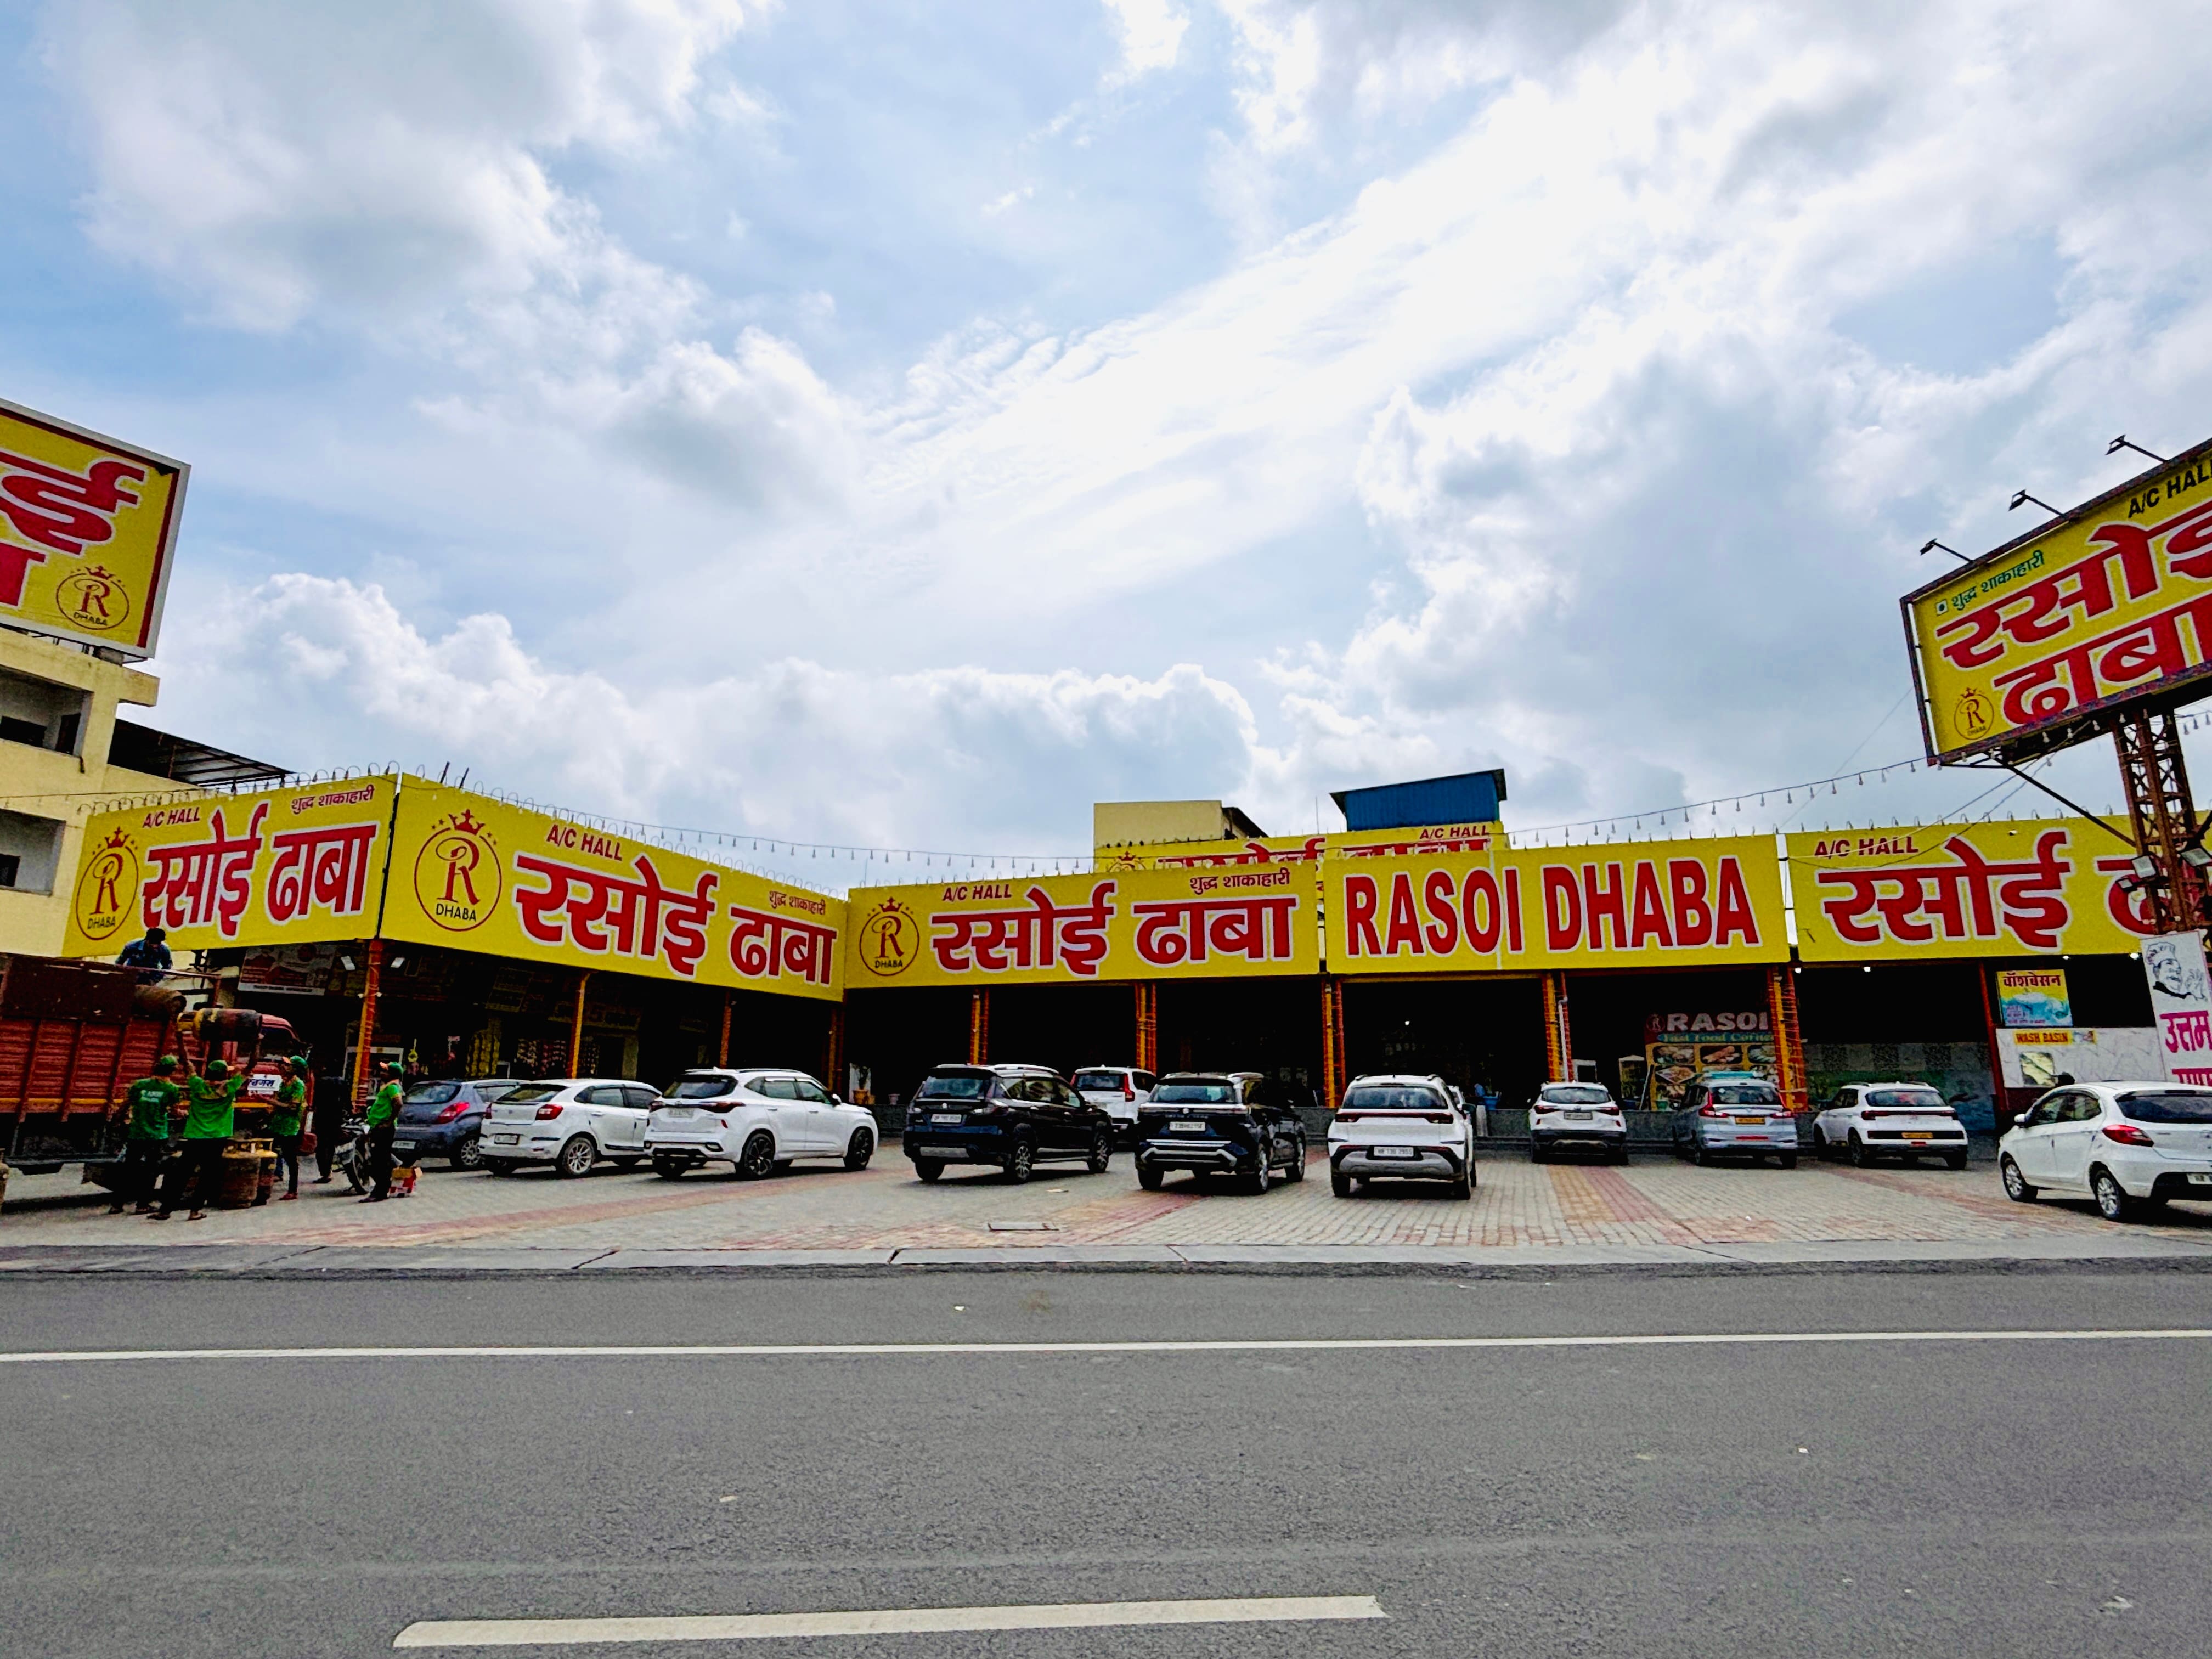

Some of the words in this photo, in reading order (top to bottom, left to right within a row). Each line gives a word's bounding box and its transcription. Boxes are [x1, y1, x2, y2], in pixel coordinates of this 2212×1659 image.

[2129, 488, 2159, 518] A/C
[2167, 460, 2212, 499] HAL
[1952, 586, 1978, 611] शुद्ध
[1981, 550, 2045, 592] शाकाहारी
[74, 612, 108, 626] DHABA
[292, 798, 314, 815] शुद्ध
[319, 784, 375, 808] शाकाहारी
[143, 810, 164, 828] A/C
[167, 806, 200, 825] HALL
[546, 825, 577, 849] A/C
[581, 835, 623, 861] HALL
[1419, 828, 1444, 840] A/C
[1449, 825, 1489, 838] HALL
[1814, 840, 1850, 859] A/C
[1858, 835, 1919, 856] HALL
[143, 802, 269, 936] रसोई
[268, 824, 376, 922] ढाबा
[942, 885, 967, 902] A/C
[972, 884, 1012, 900] HALL
[1189, 877, 1218, 895] शुद्ध
[1223, 870, 1290, 890] शाकाहारी
[1818, 831, 2070, 948] रसोई
[436, 902, 476, 922] DHABA
[769, 891, 786, 909] शुद्ध
[789, 894, 826, 916] शाकाहारी
[1345, 866, 1522, 956] RASOI
[1543, 856, 1759, 951] DHABA
[87, 916, 116, 930] DHABA
[516, 855, 719, 976] रसोई
[730, 907, 837, 985] ढाबा
[932, 883, 1115, 975] रसोई
[1135, 898, 1296, 964] ढाबा
[874, 960, 903, 969] DHABA
[1667, 1012, 1768, 1032] RASOI
[2016, 1032, 2041, 1043] WASH
[2043, 1032, 2068, 1043] BASIN
